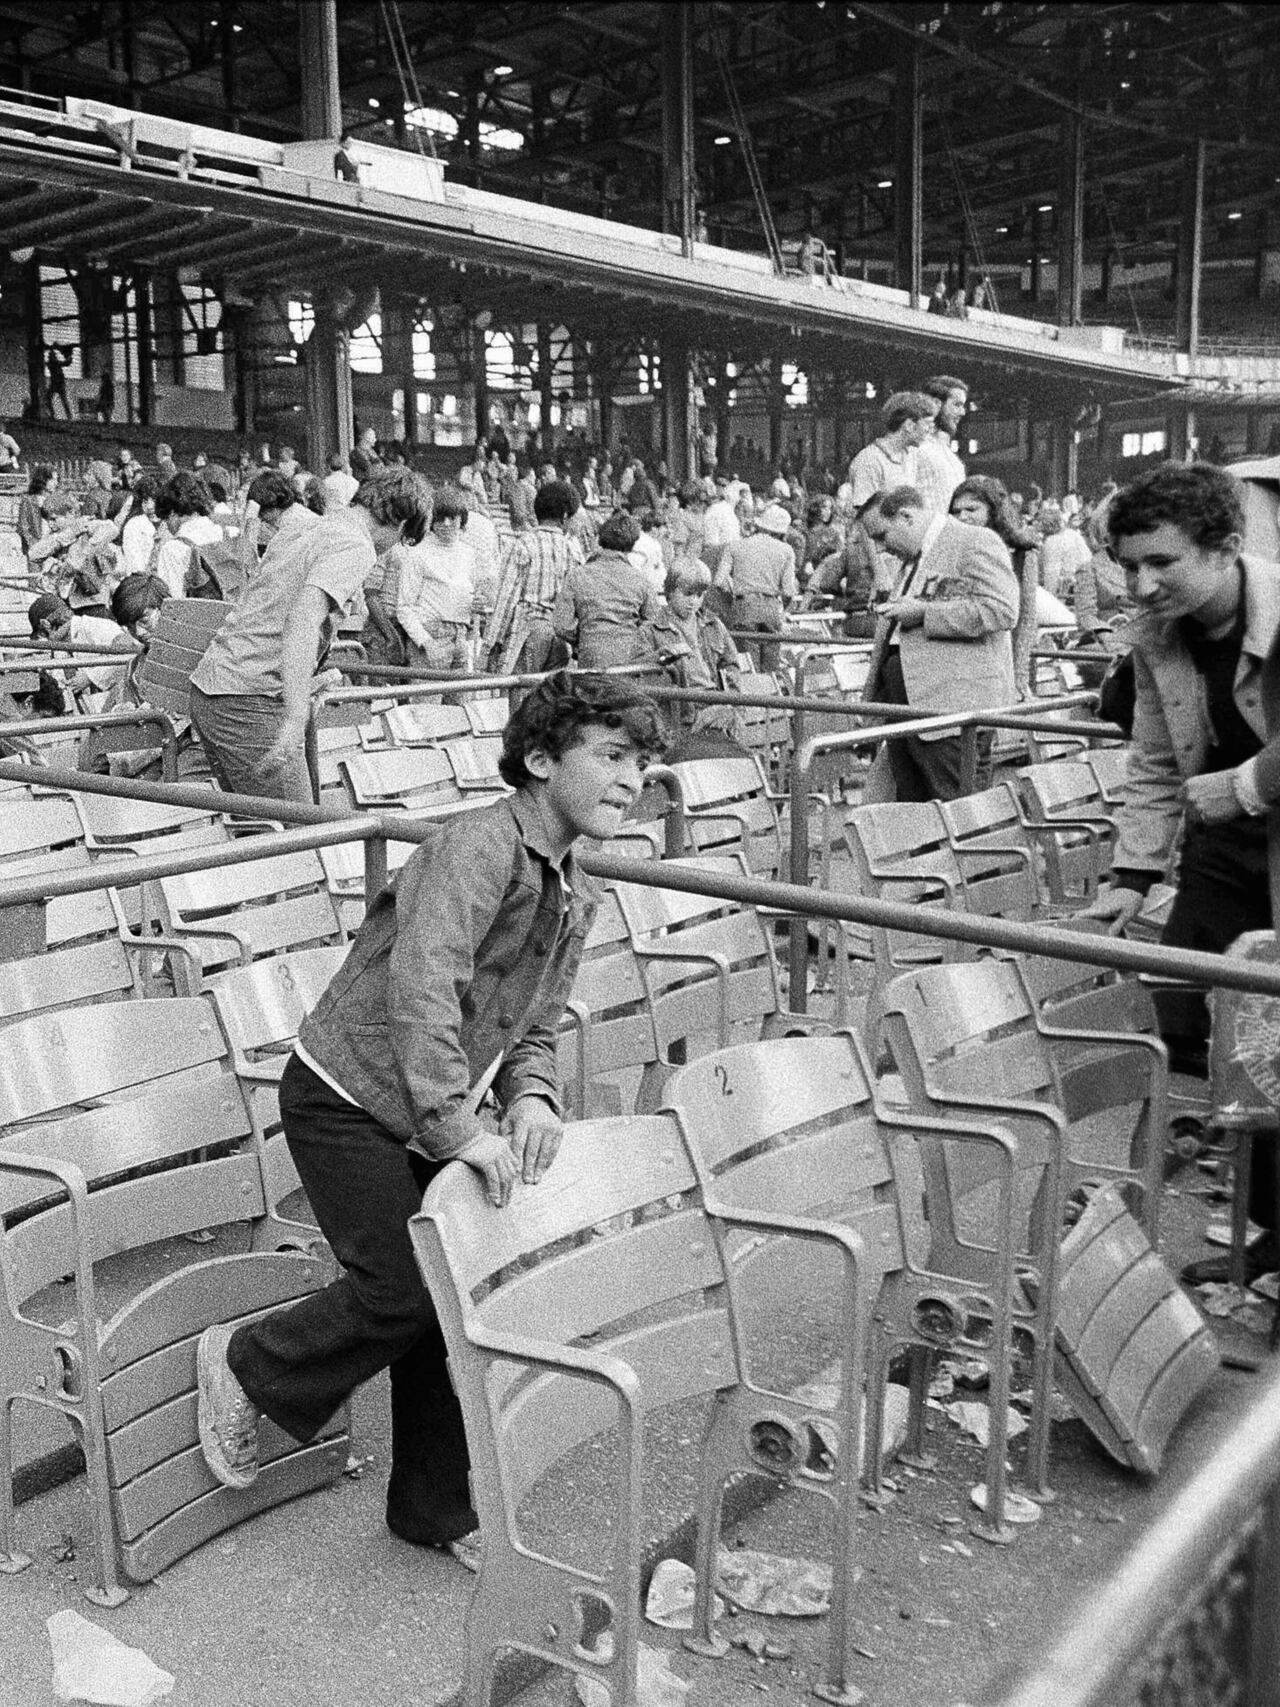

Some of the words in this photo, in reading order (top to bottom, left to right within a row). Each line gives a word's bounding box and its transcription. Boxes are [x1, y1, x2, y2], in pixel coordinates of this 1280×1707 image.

[276, 961, 297, 993] 3
[915, 980, 929, 1008] 1
[49, 1019, 67, 1049] 4
[714, 1065, 735, 1097] 2
